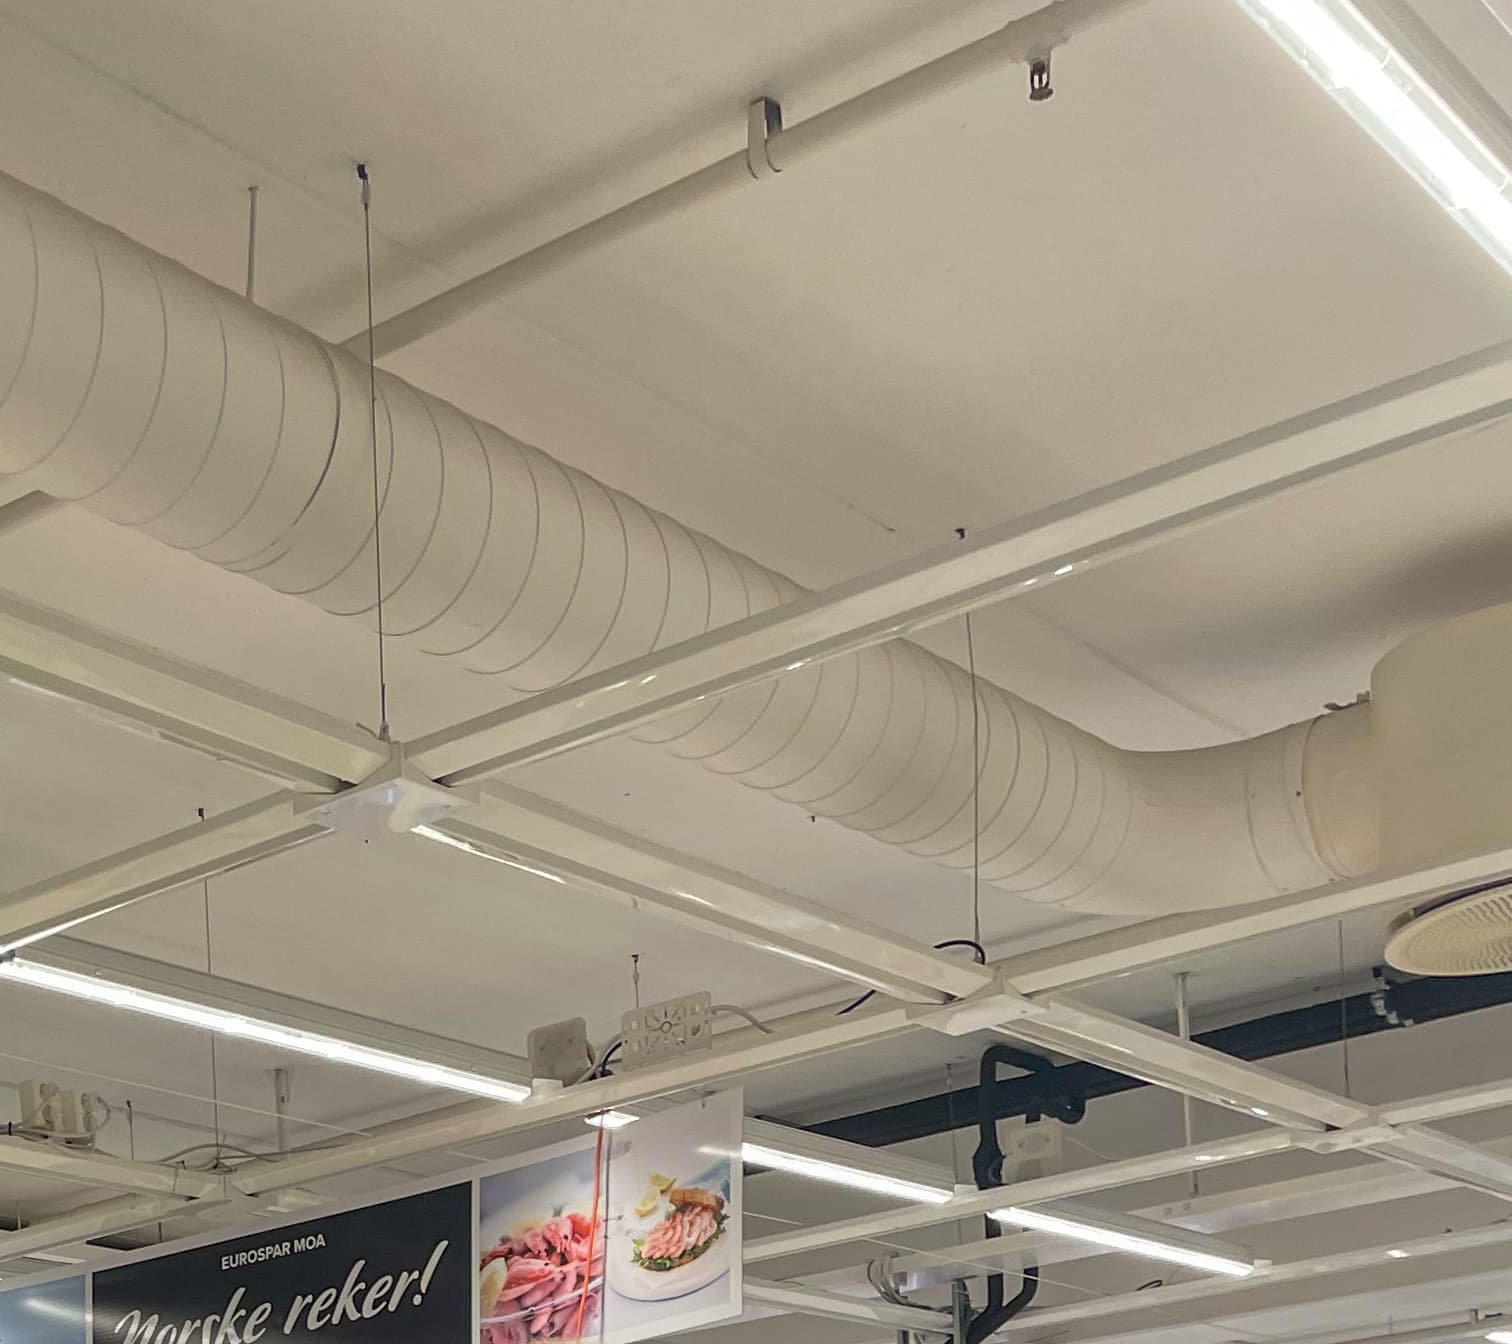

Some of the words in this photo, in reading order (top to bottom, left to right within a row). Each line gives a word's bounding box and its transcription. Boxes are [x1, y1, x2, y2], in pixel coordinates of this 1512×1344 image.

[221, 1242, 291, 1271] EUROSPAR
[293, 1233, 326, 1254] MOA
[283, 1240, 449, 1336] reker!
